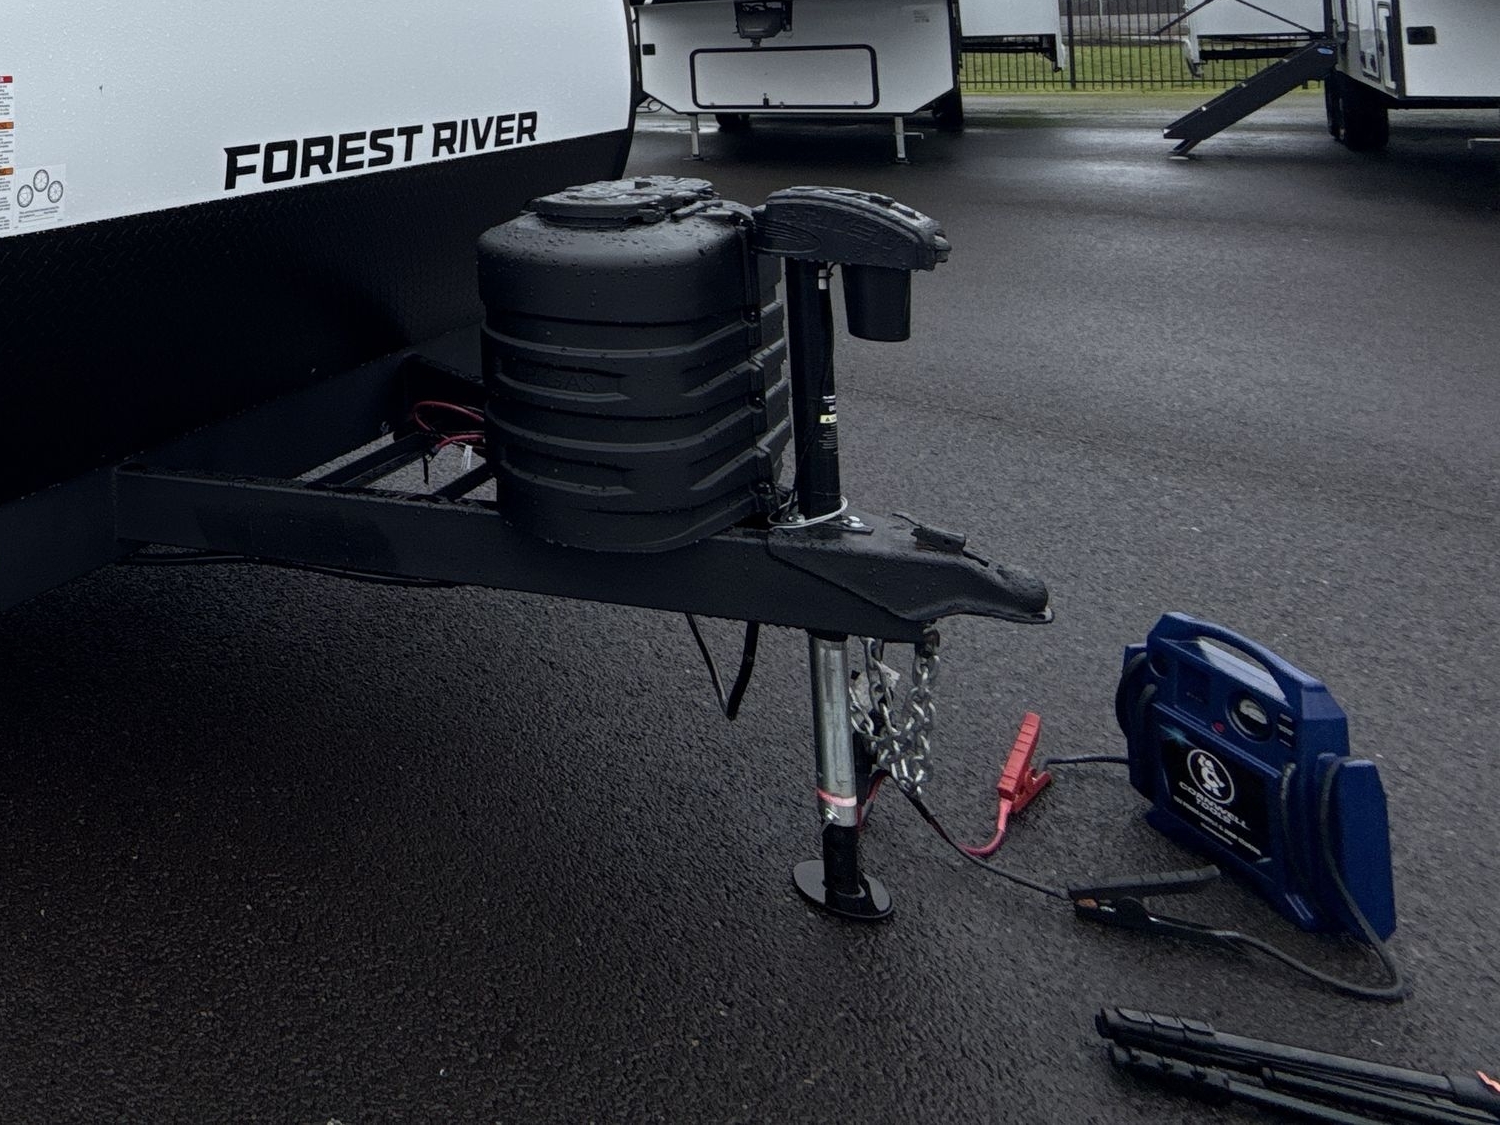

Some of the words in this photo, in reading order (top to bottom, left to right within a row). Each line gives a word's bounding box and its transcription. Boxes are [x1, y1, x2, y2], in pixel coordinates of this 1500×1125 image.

[223, 124, 424, 191] FOREST
[431, 111, 538, 157] RIVER
[1178, 781, 1251, 831] CORNWELL
[1196, 798, 1232, 824] TOOLS
